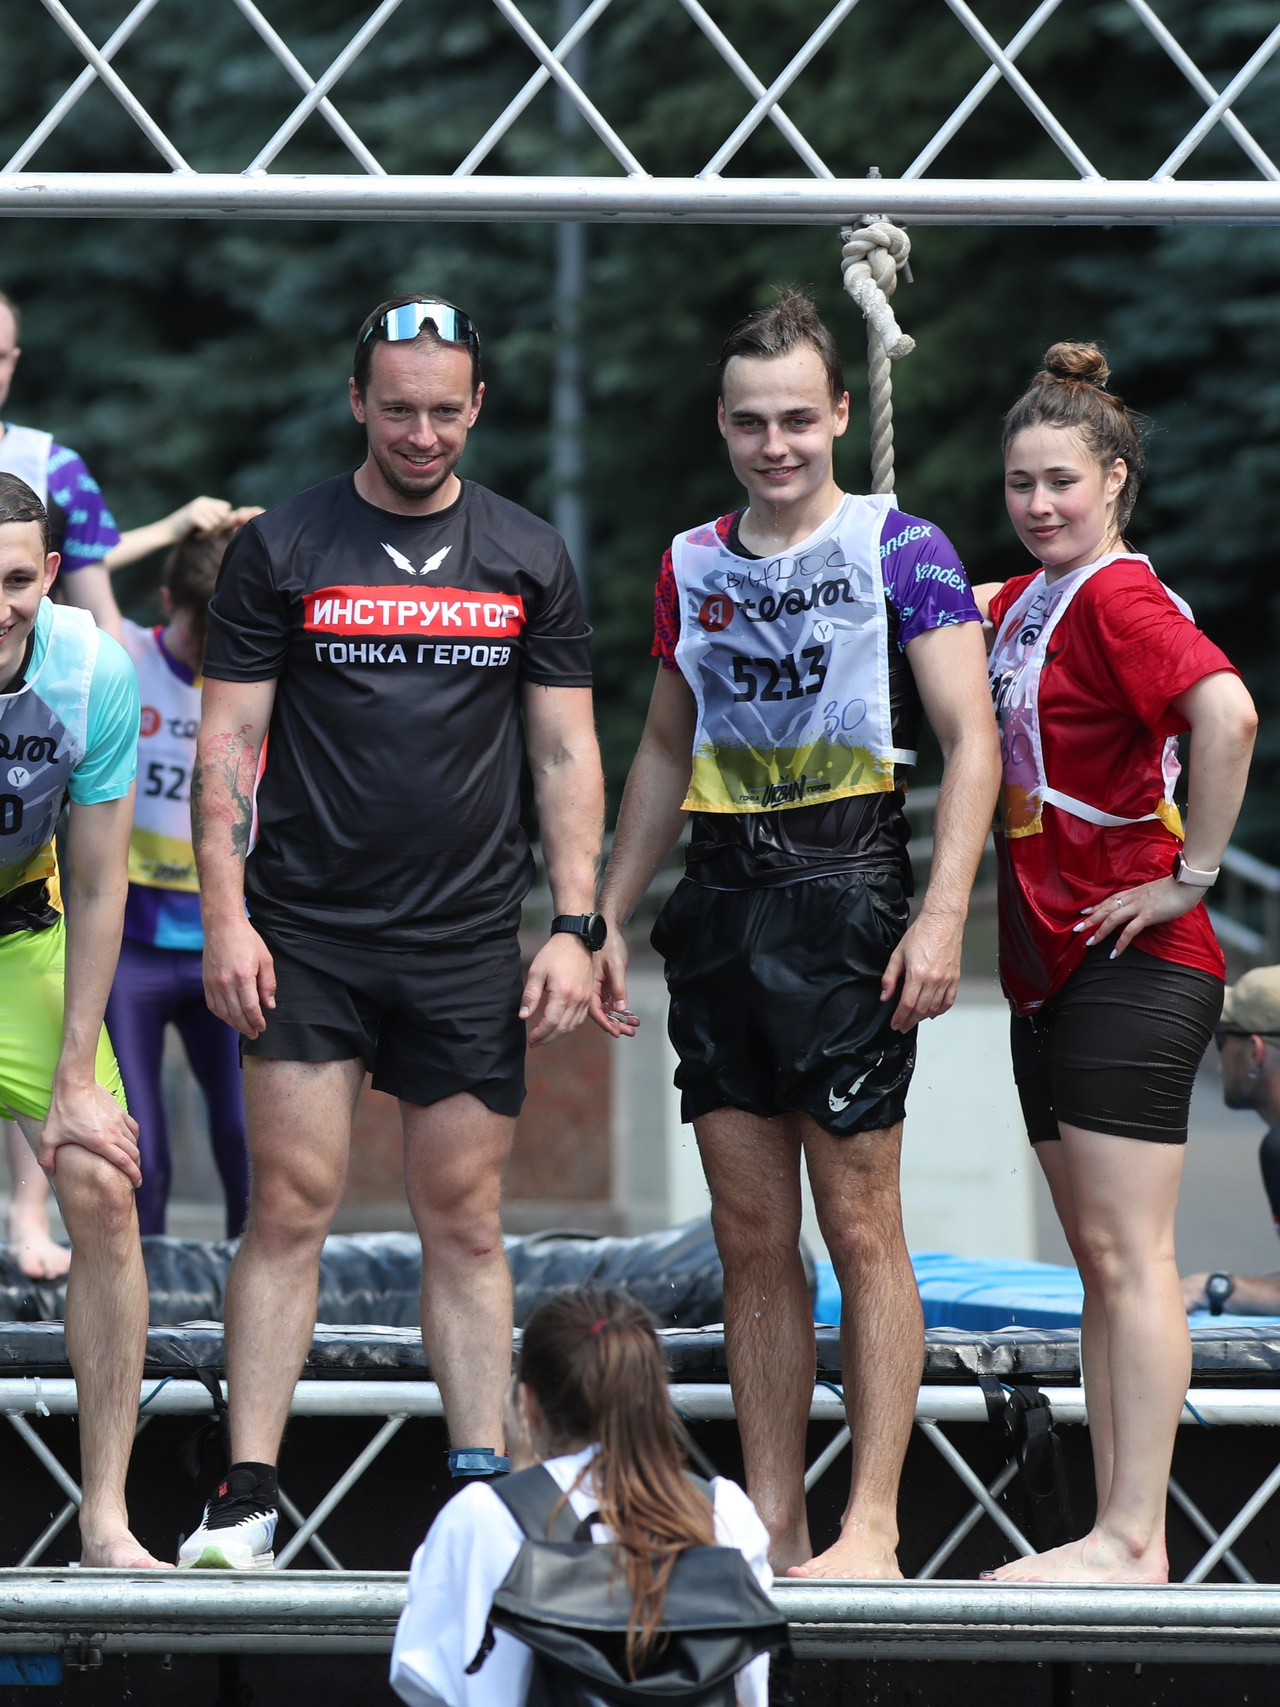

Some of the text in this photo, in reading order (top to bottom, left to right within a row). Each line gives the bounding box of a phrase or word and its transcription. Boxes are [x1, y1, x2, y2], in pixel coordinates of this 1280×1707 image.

[914, 560, 967, 594] Yndex
[312, 598, 519, 628] ИНСТРУКТОР
[708, 601, 723, 626] Я
[734, 578, 855, 622] team
[314, 642, 511, 667] ГОНКА ГЕРОЕВ
[732, 645, 827, 703] 5213
[822, 698, 868, 737] 30
[761, 774, 807, 809] URBAN
